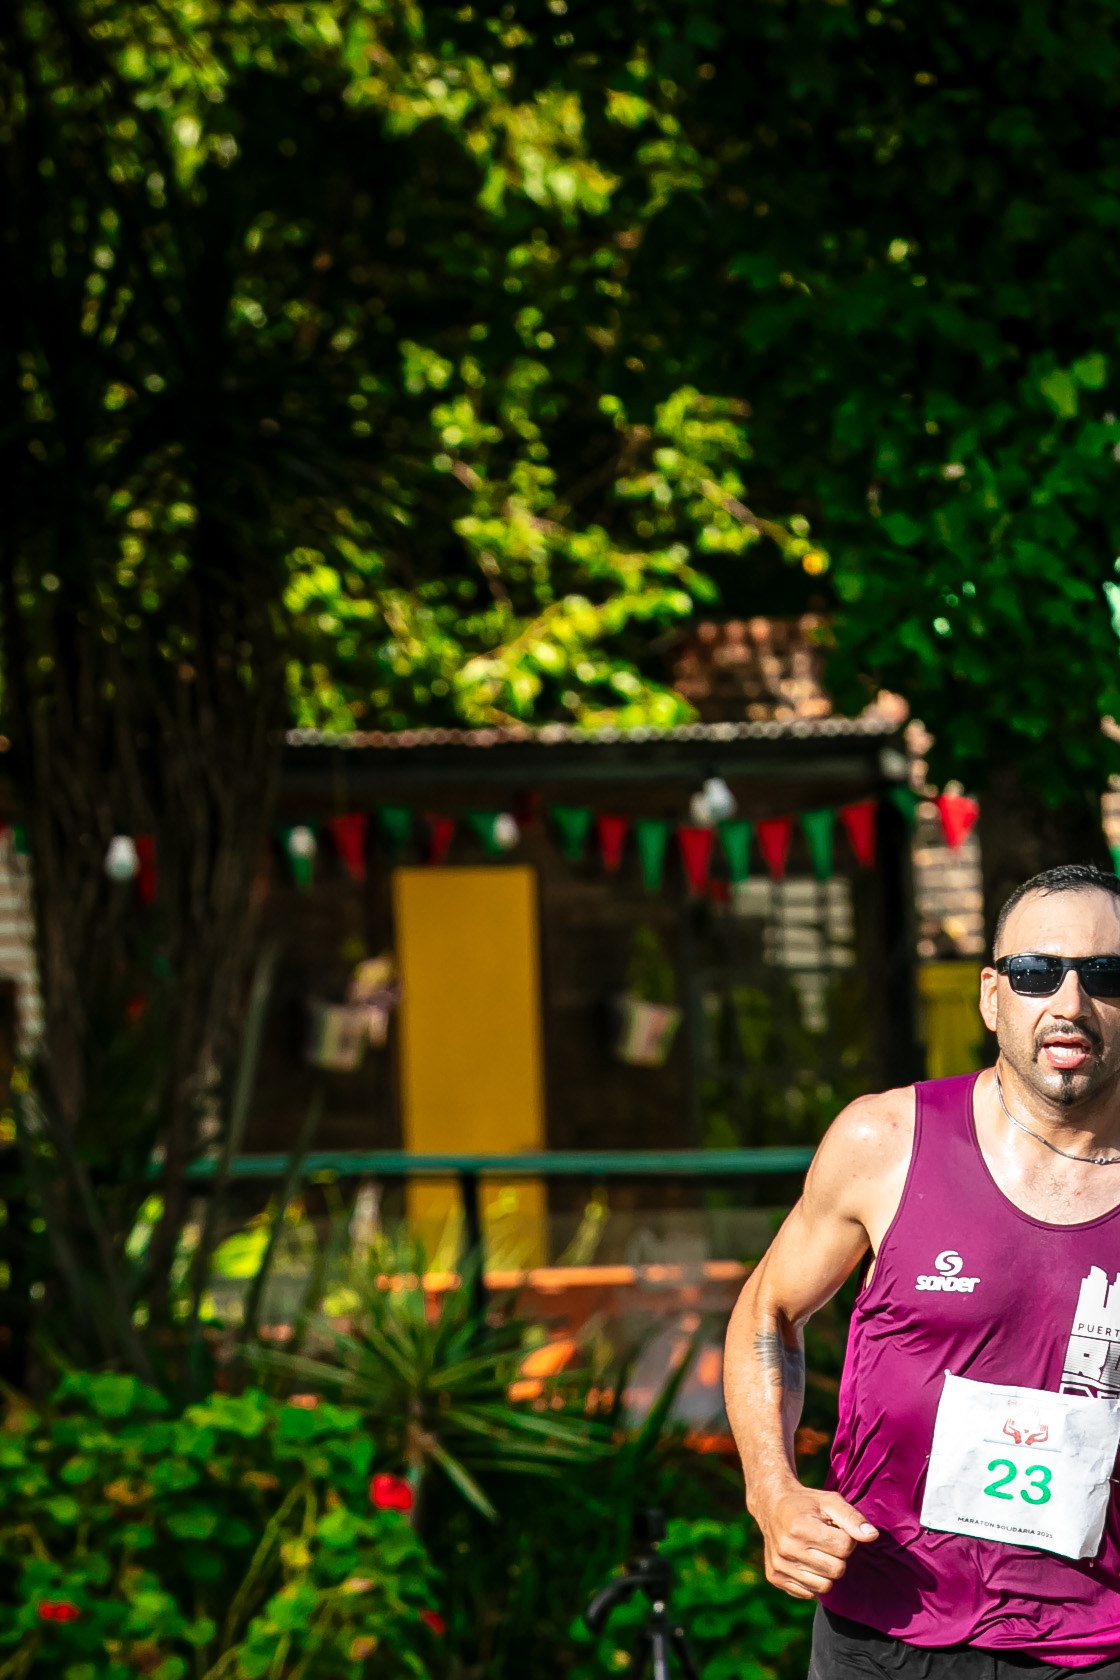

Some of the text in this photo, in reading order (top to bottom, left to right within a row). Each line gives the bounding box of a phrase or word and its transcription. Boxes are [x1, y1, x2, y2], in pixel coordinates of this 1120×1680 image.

[983, 1458, 1053, 1505] 23
[957, 1516, 1053, 1539] MARATON SOLIDARIA 2025
